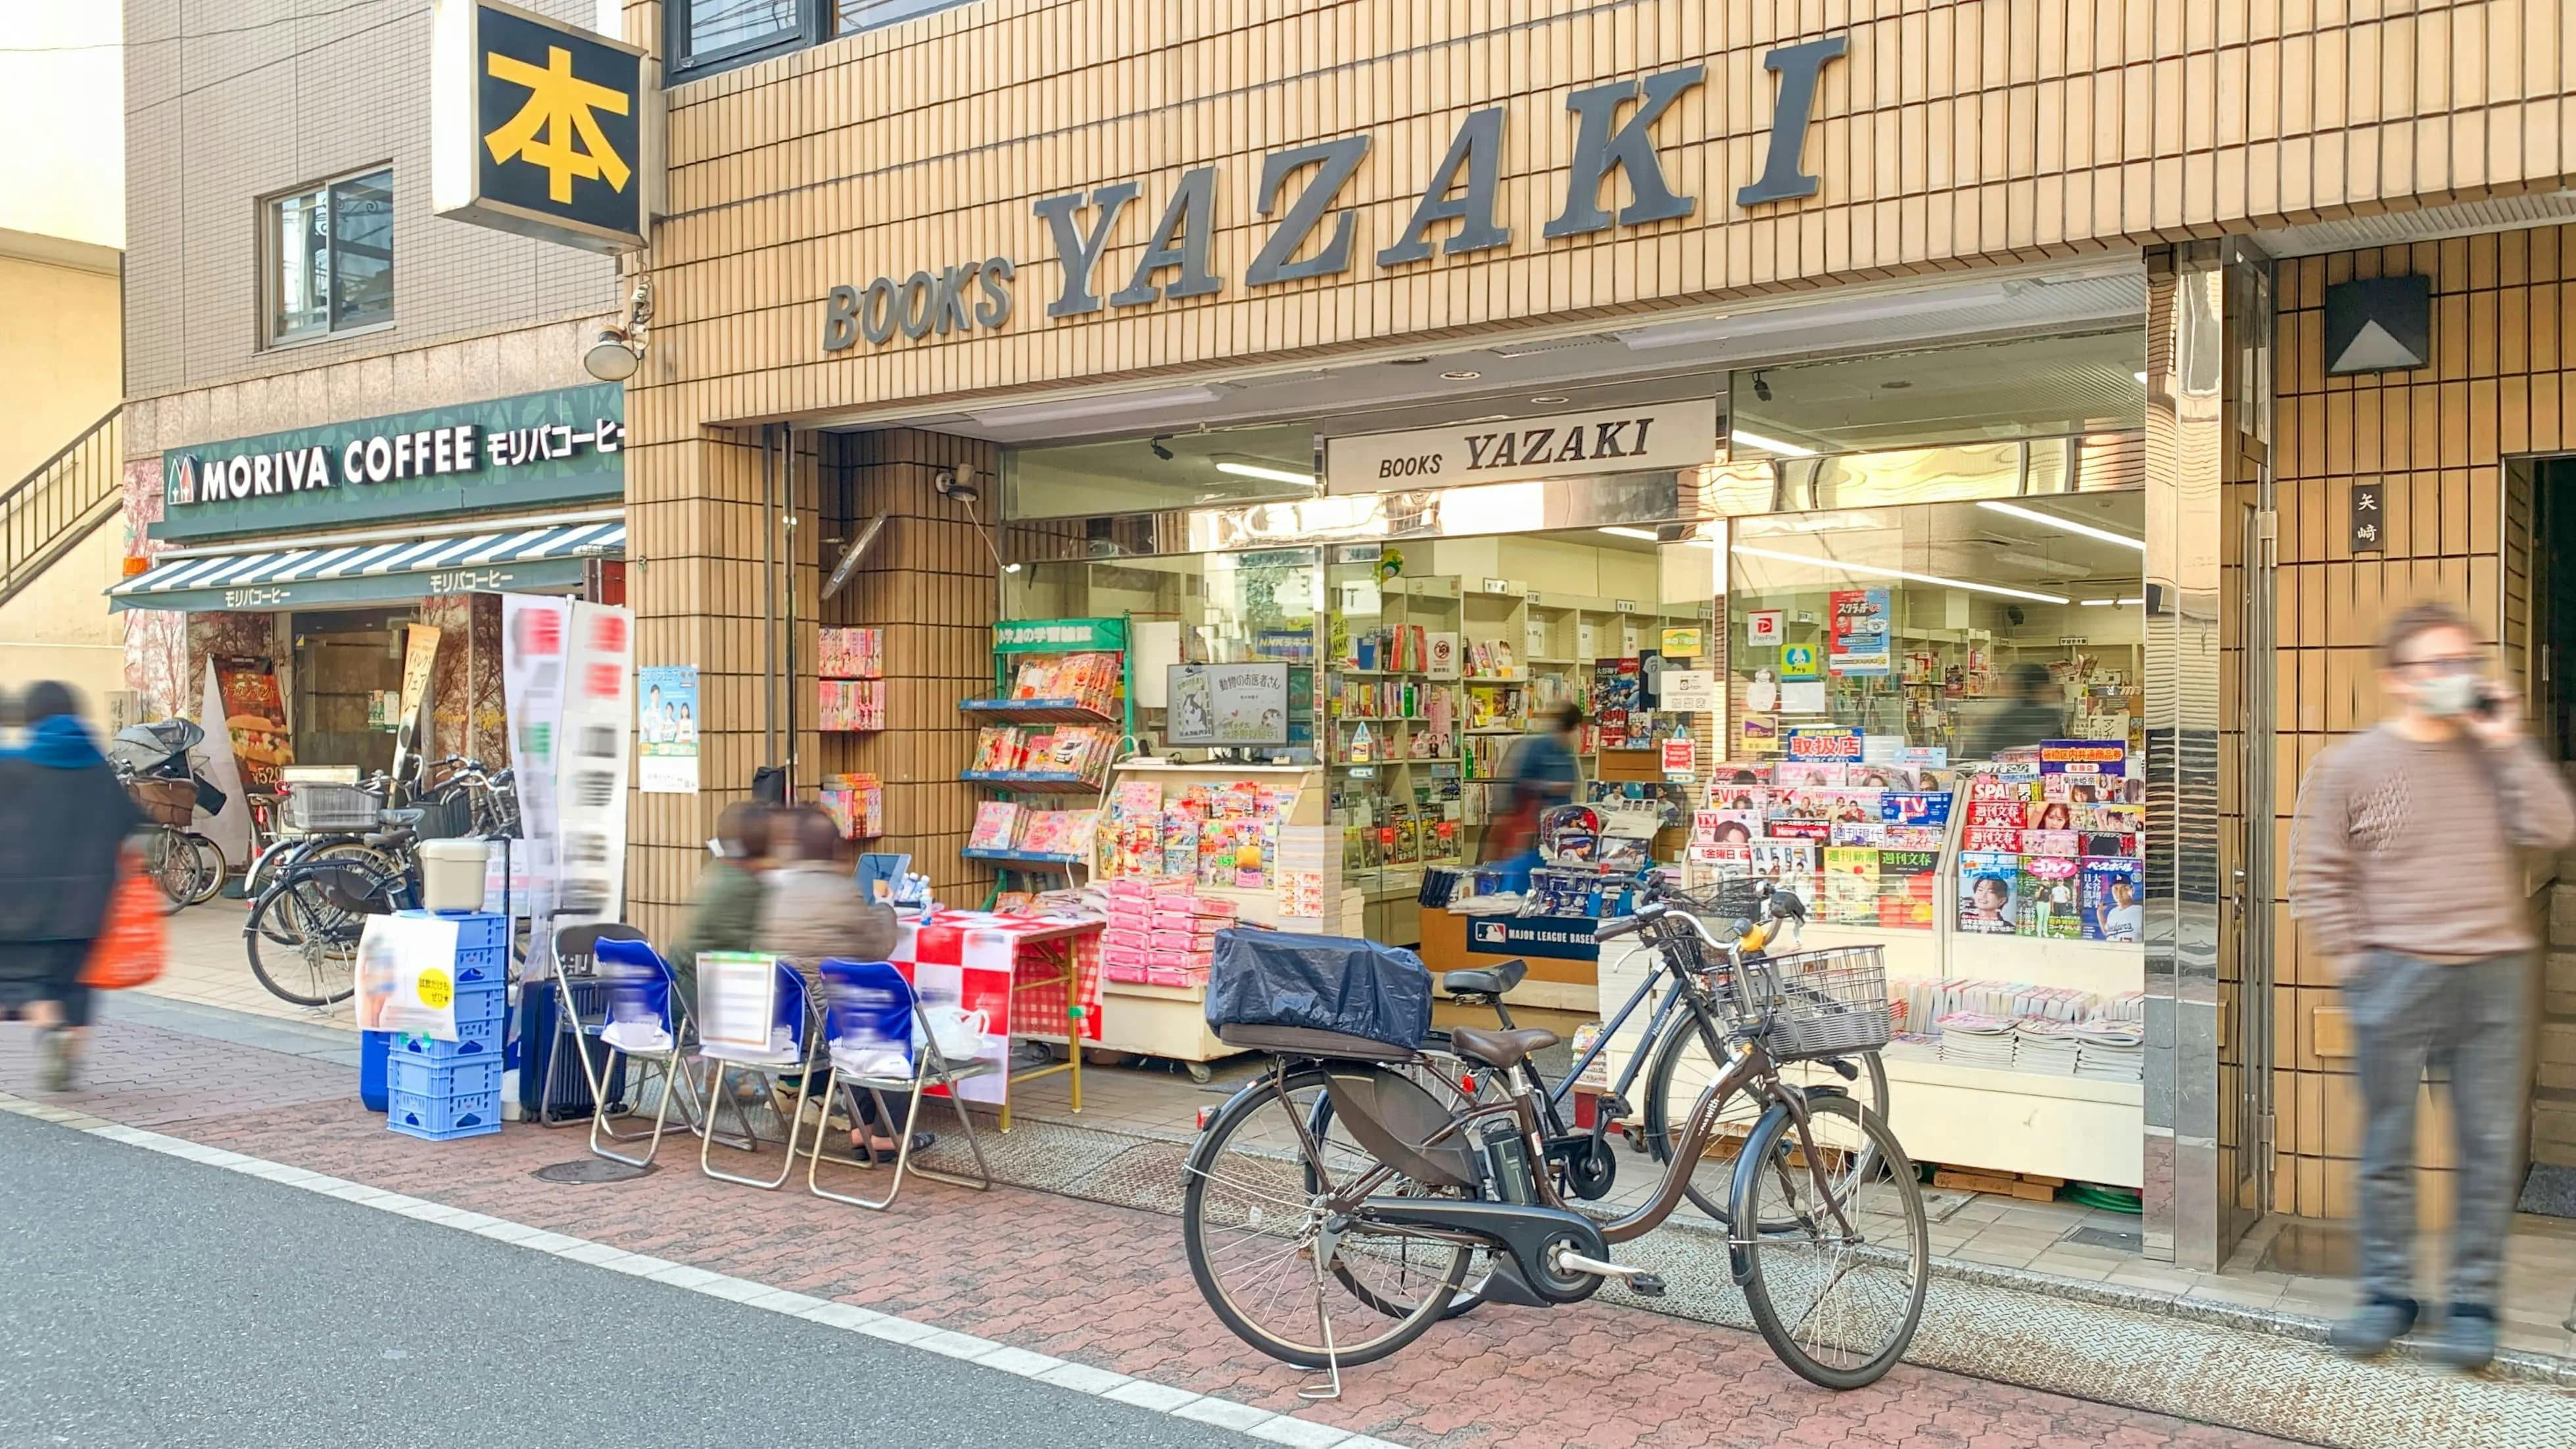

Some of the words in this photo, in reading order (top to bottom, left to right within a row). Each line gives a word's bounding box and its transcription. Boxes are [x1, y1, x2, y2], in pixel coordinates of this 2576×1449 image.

[484, 45, 631, 204] 本
[823, 255, 1015, 352] BOOKS
[1034, 37, 1848, 316] YAZAKI
[1379, 454, 1443, 478] BOOKS
[1464, 418, 1654, 471] YAZAKI
[202, 446, 329, 502] MORIVA
[344, 429, 475, 484] COFFEE
[431, 570, 513, 593] モリバコーヒー
[225, 587, 291, 607] モリバコーヒー
[1333, 636, 1348, 656] NHK
[1218, 673, 1281, 692] 動物のお医者さん
[1791, 736, 1861, 755] 取扱店
[1974, 783, 2010, 800] SPA!
[1833, 826, 1884, 841] 週刊現代
[1882, 852, 1932, 867] 週刊文春
[1509, 929, 1535, 940] MAJOR
[1537, 931, 1567, 943] LEAGUE
[1570, 933, 1598, 945] BASEB
[1707, 1098, 1721, 1119] with
